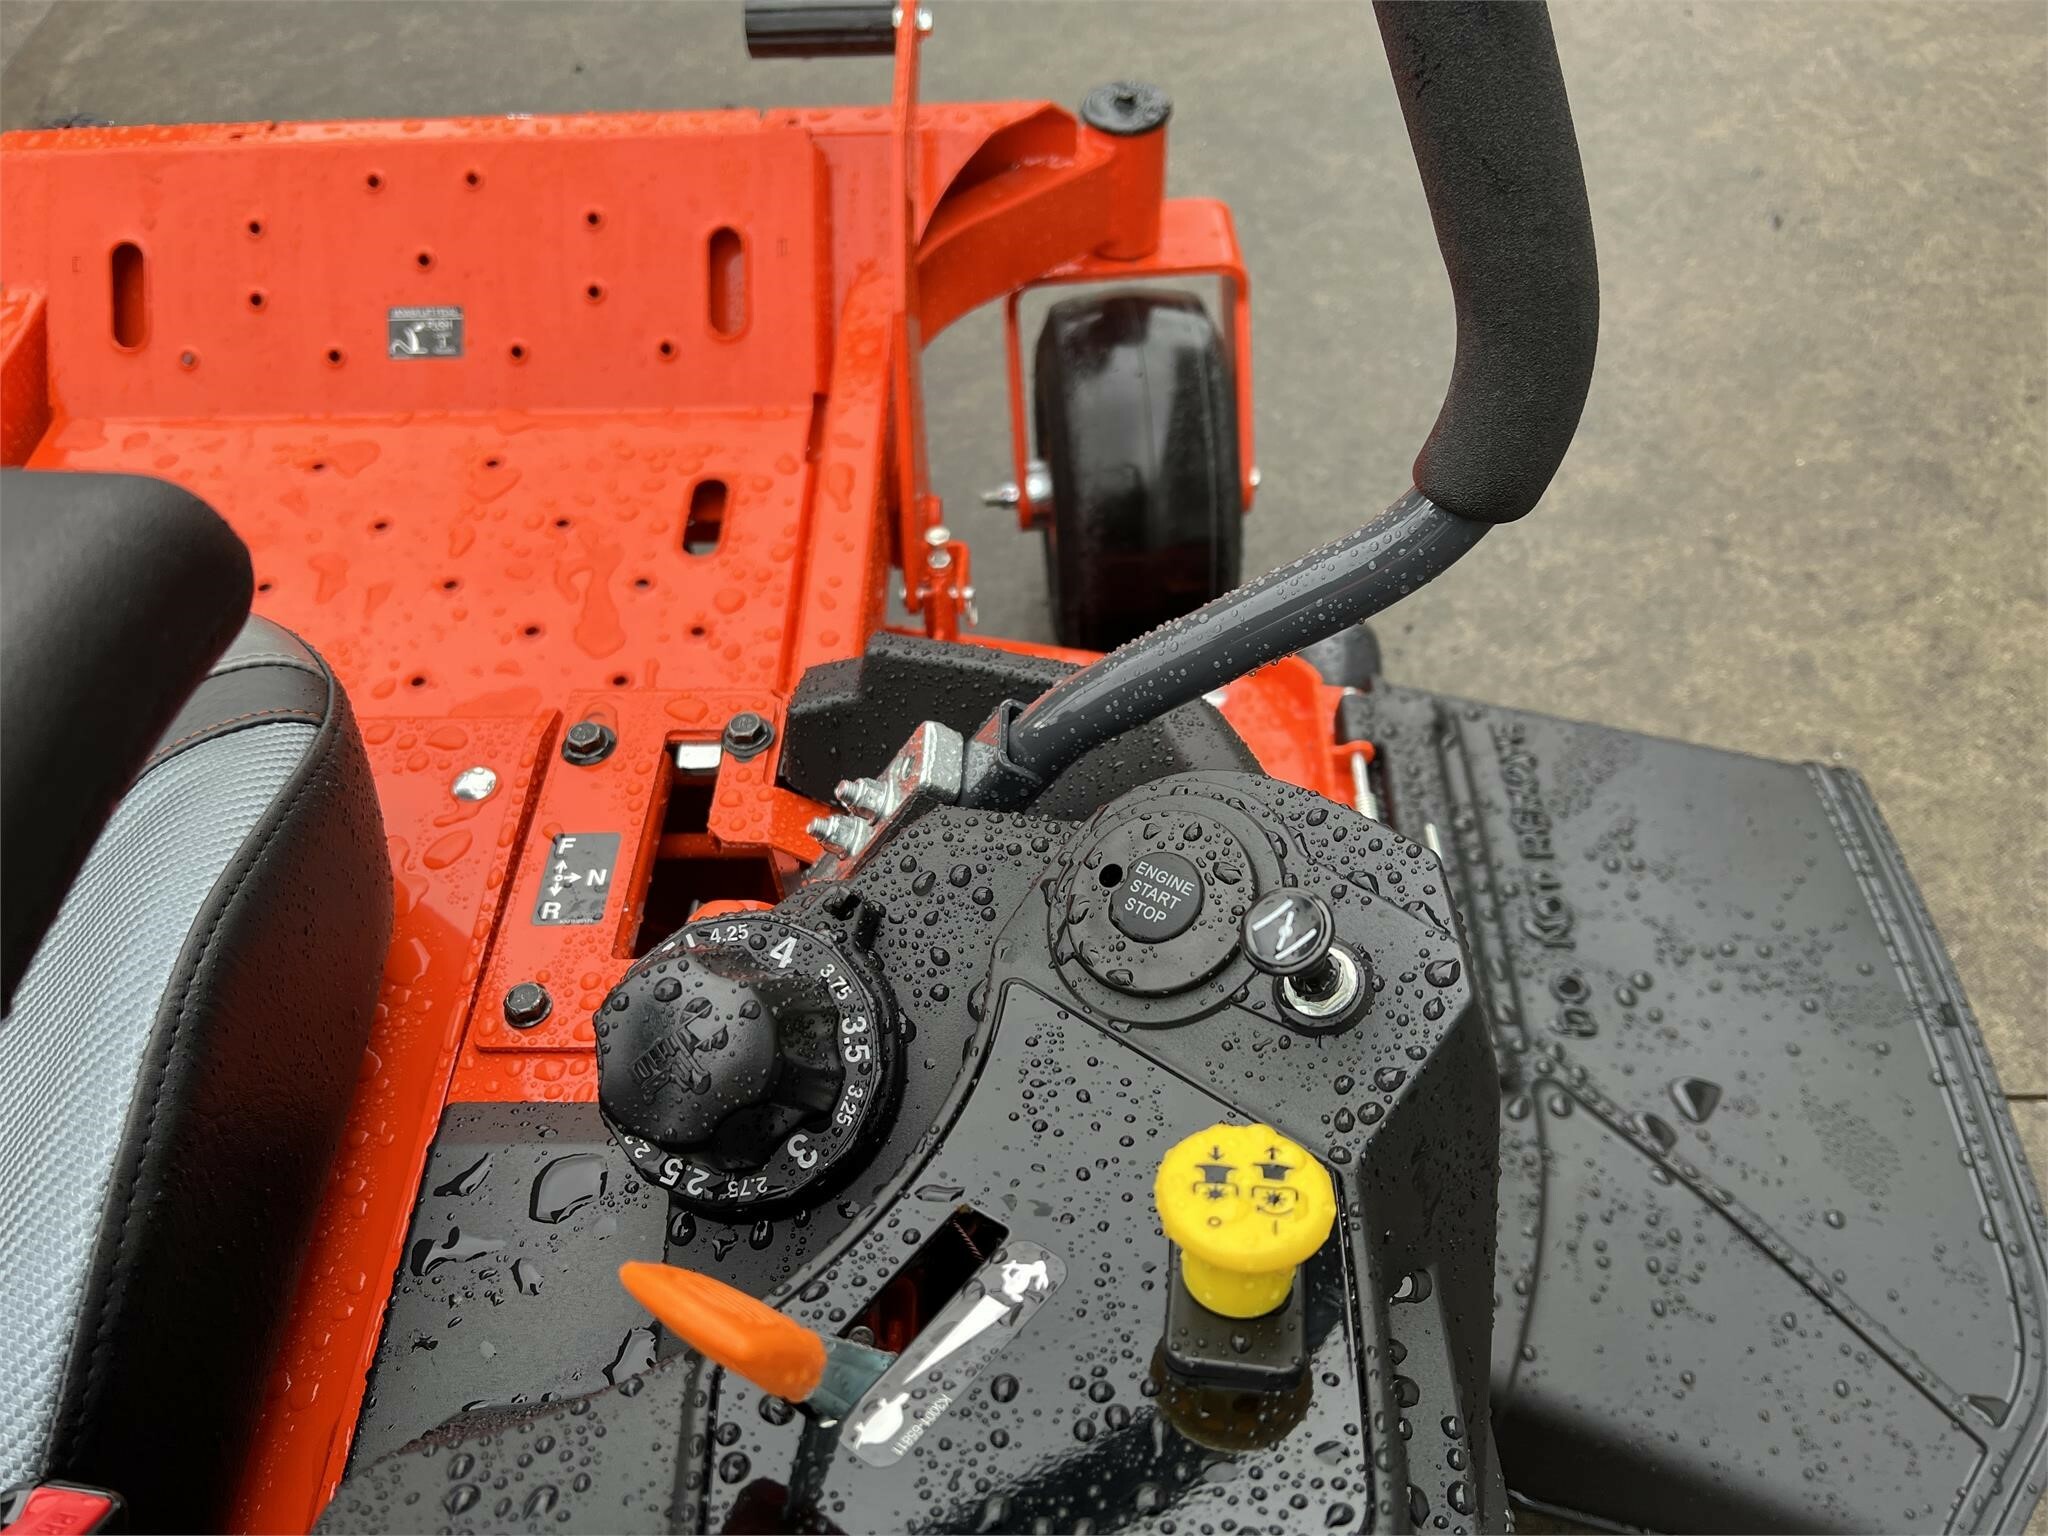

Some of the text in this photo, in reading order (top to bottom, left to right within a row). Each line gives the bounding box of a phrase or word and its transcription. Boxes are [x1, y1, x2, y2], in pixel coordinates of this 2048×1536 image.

[558, 837, 577, 855] F
[586, 868, 608, 886] N
[1135, 861, 1195, 896] ENGINE
[541, 901, 562, 920] R
[1124, 897, 1167, 923] STOP
[1130, 879, 1181, 910] START
[709, 923, 749, 943] 4.25
[769, 935, 798, 969] 4
[818, 963, 854, 1001] 3.75
[841, 1016, 871, 1063] 3.5
[835, 1084, 864, 1127] 3.25
[786, 1133, 819, 1169] 3
[659, 1157, 711, 1196] 2.5
[727, 1175, 768, 1198] 2.75
